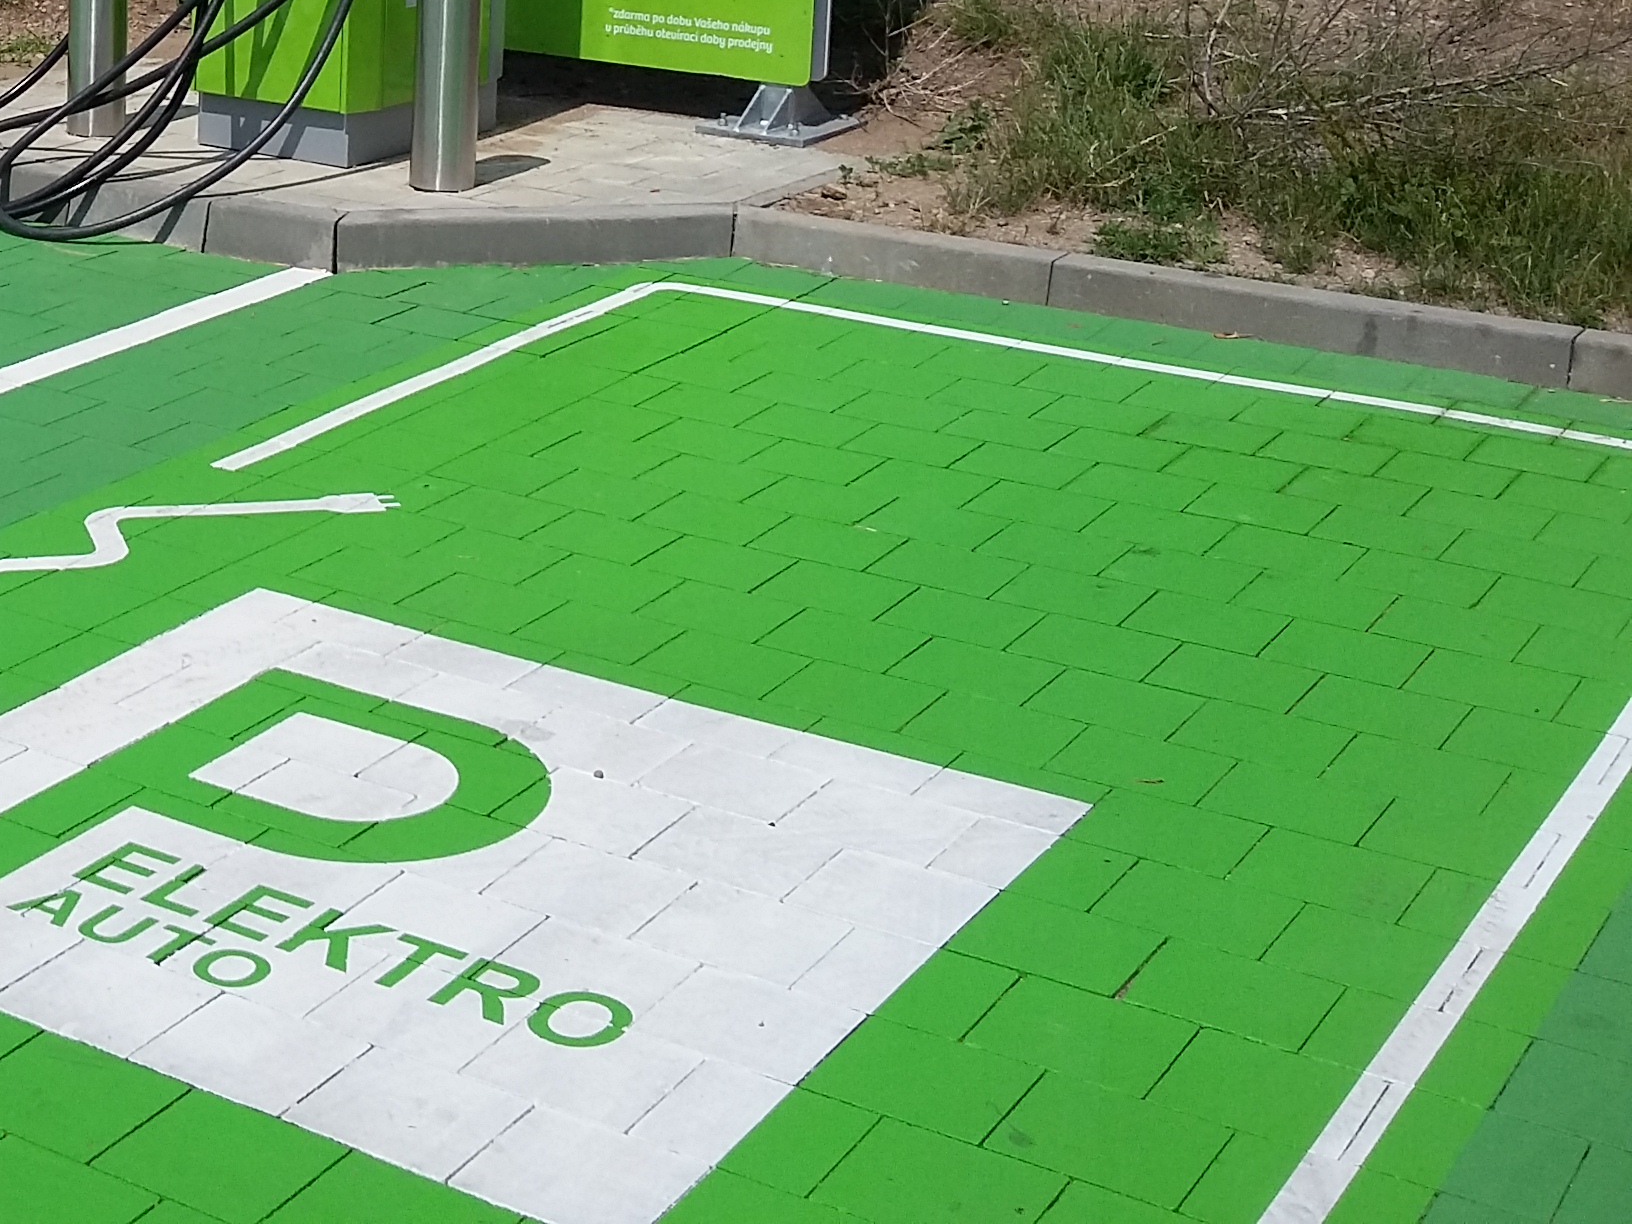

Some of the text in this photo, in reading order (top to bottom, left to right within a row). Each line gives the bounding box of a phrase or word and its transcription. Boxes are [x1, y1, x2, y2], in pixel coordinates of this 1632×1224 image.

[652, 14, 665, 25] po
[667, 14, 692, 27] dobu
[694, 17, 730, 31] Vašeho
[732, 20, 771, 37] nákupu
[700, 33, 726, 49] doby
[728, 37, 773, 54] prodejny
[7, 888, 273, 988] AUTO
[71, 841, 635, 1048] ELEKTRO
